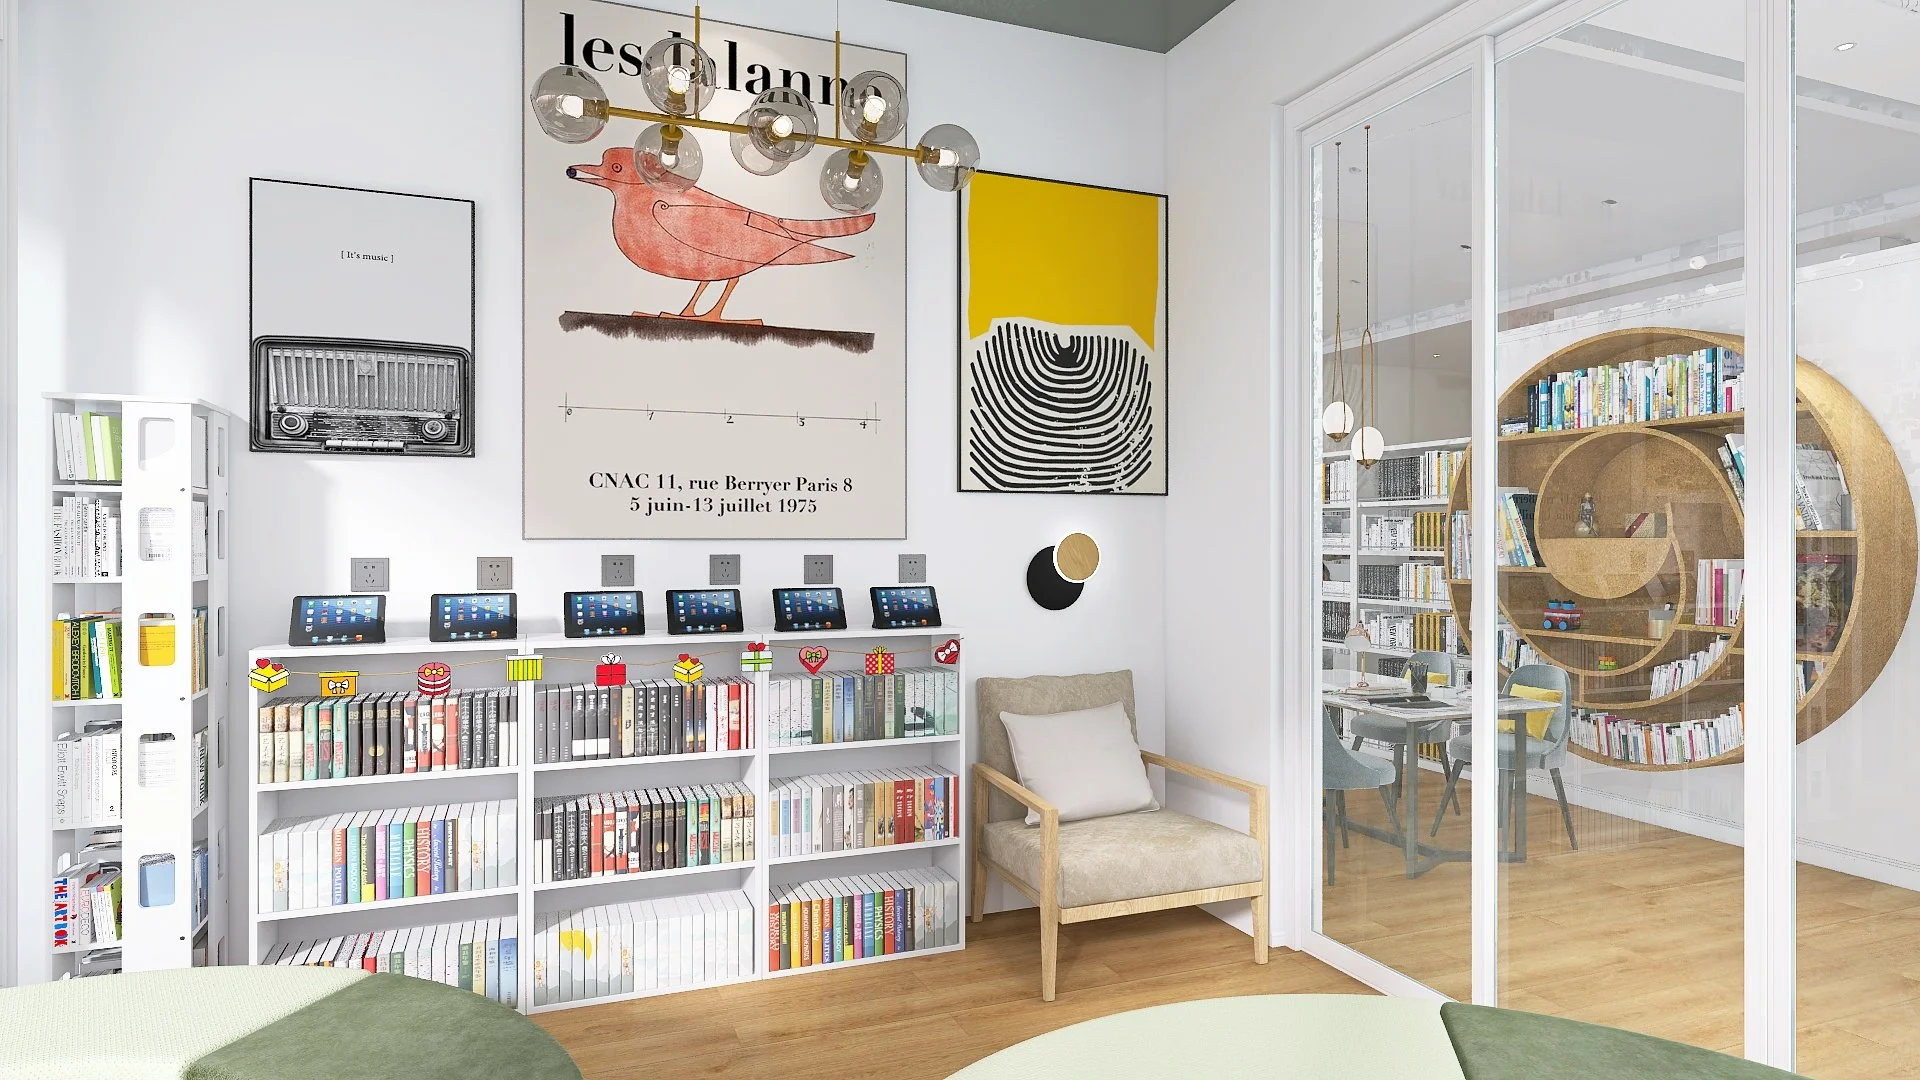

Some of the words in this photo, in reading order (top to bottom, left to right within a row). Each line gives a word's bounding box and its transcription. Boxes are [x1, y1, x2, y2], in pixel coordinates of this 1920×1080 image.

[559, 12, 643, 77] les
[346, 250, 361, 259] It's
[362, 253, 389, 262] music
[725, 414, 735, 424] 2
[859, 419, 868, 430] 4
[588, 471, 650, 490] CNAC
[655, 473, 683, 492] 11,
[688, 478, 720, 491] rue
[724, 475, 791, 496] Berryer
[795, 476, 839, 493] Paris
[843, 477, 853, 493] 8
[629, 497, 641, 512] 5
[645, 497, 713, 517] juin-13
[717, 497, 772, 518] juillet
[777, 498, 817, 513] 1975
[335, 828, 343, 864] MODERN
[403, 838, 415, 879] PHYSICS
[416, 827, 431, 874] HISTORY
[54, 877, 68, 900] THE
[335, 867, 343, 904] POLITICS
[350, 862, 358, 892] BIOLOGY
[54, 902, 68, 922] ART
[812, 903, 821, 941] Chemistry
[874, 905, 884, 941] PHYSICS
[884, 895, 895, 936] HISTORY
[835, 926, 843, 953] BIOLOGY
